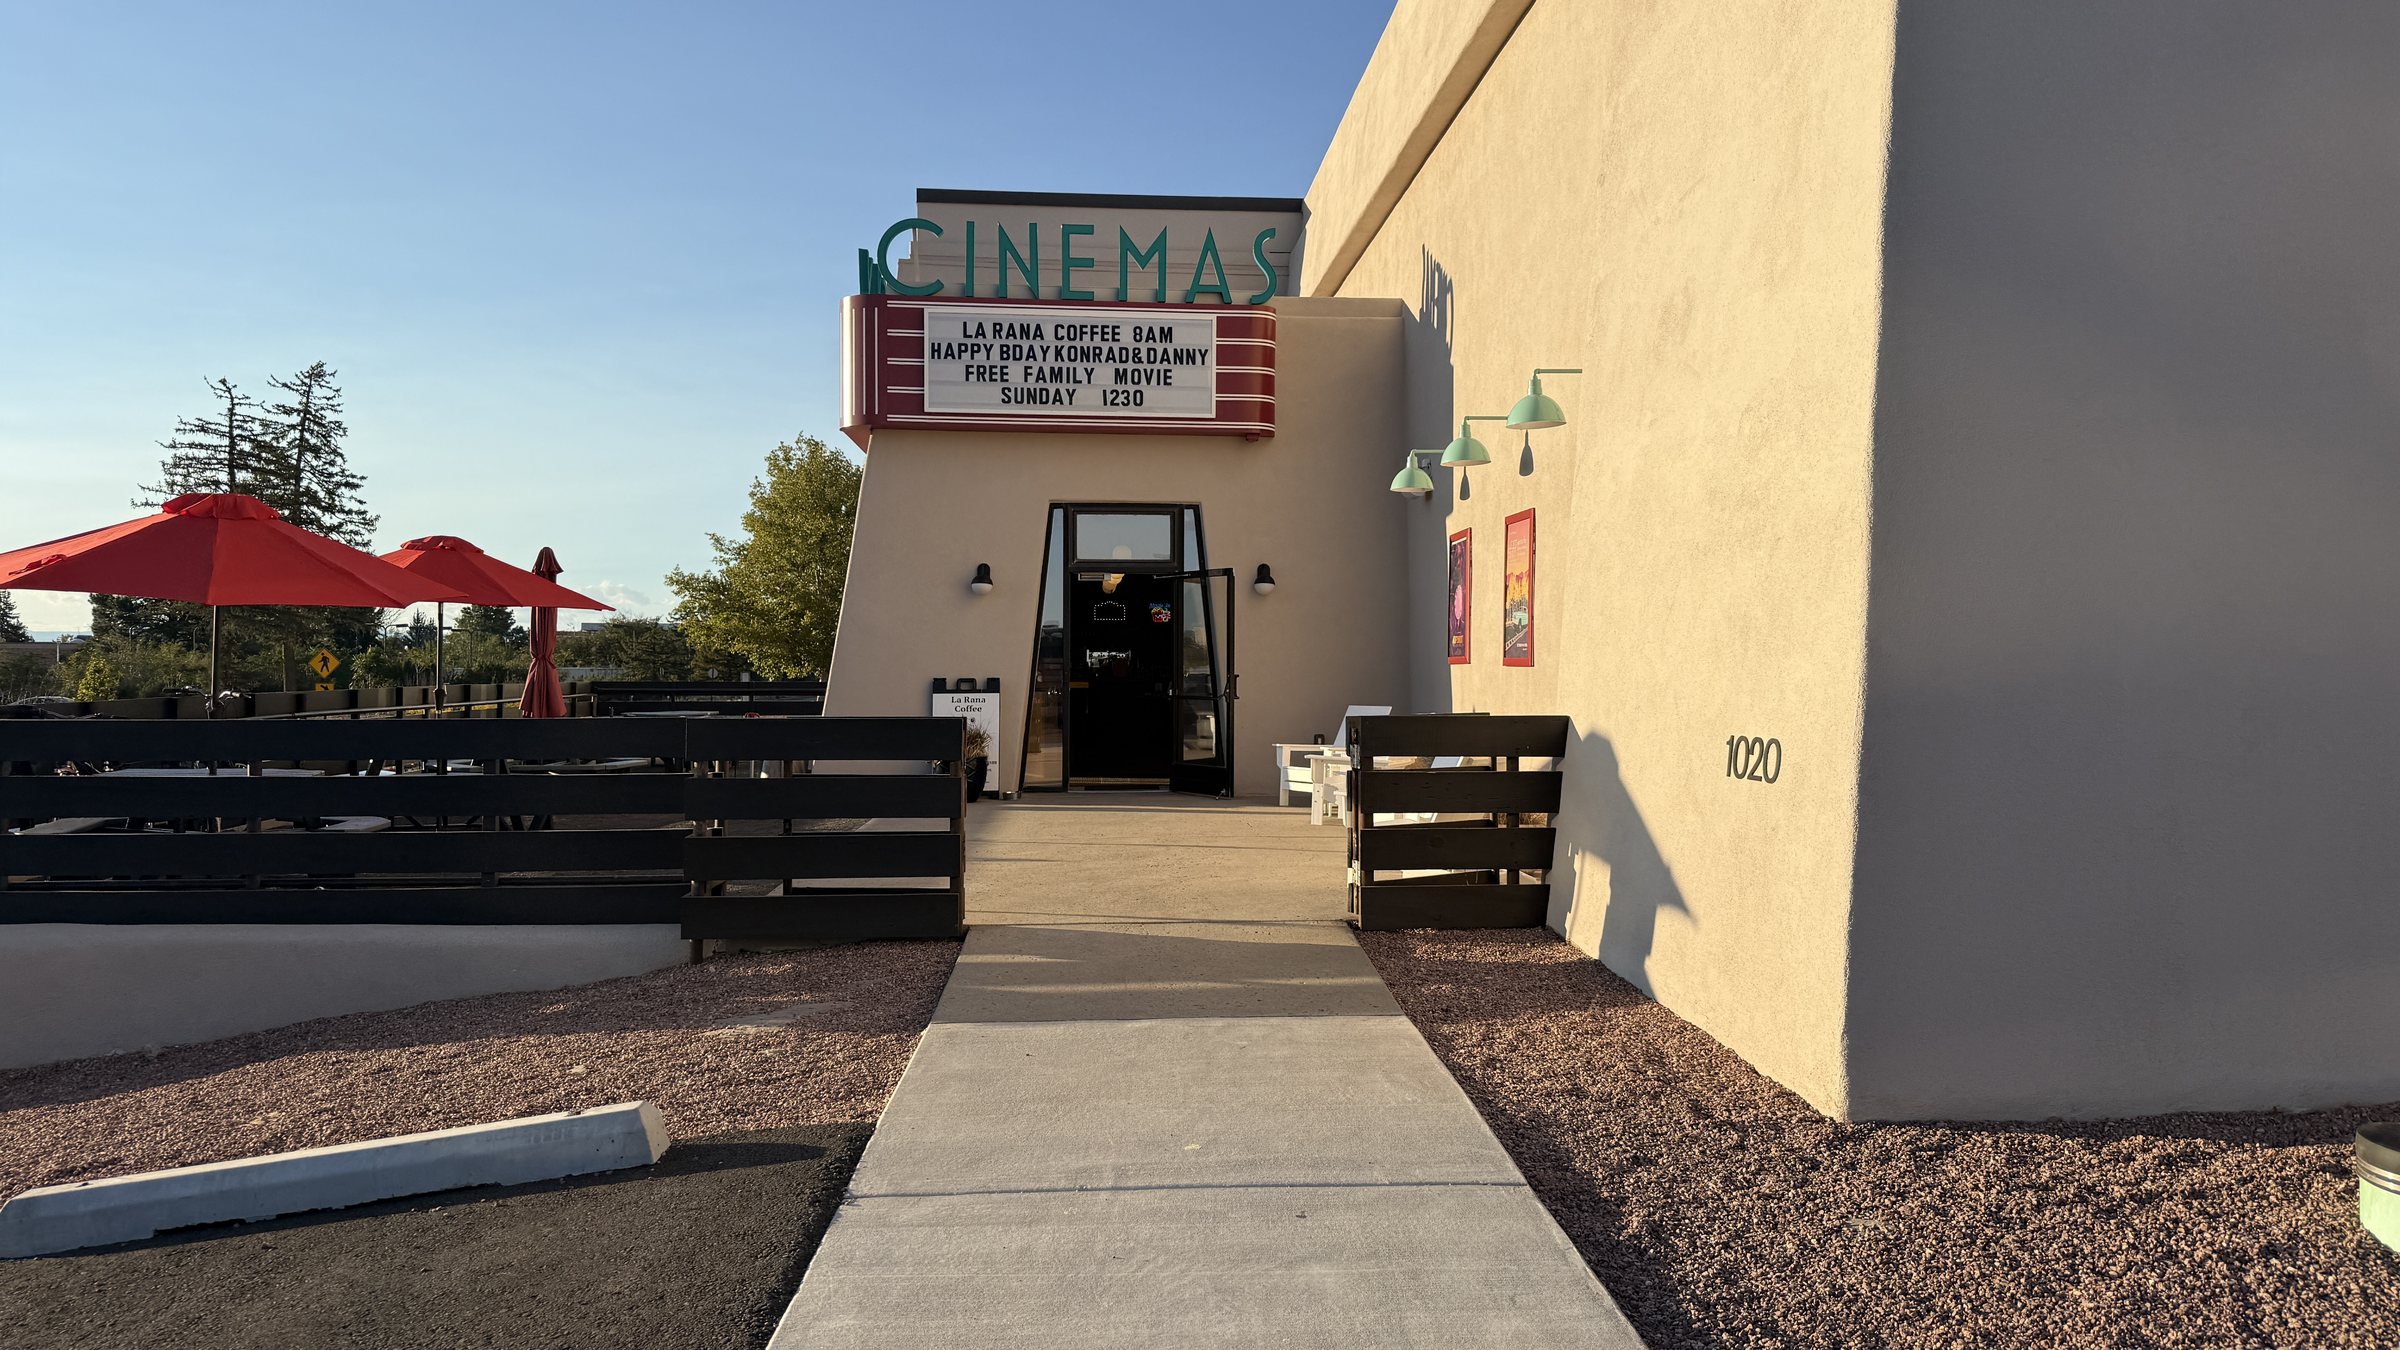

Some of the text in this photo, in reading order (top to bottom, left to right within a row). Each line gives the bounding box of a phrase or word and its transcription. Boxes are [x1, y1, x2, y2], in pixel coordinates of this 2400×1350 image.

[877, 218, 1277, 304] CINEMAS
[962, 321, 1173, 344] LA RANA COFFEE 8AM
[930, 342, 995, 360] HAPPY
[999, 344, 1051, 362] BDAY
[965, 364, 1173, 386] FREE FAMILY MOVIE
[1001, 387, 1144, 407] SUNDAY 1230
[951, 696, 986, 704] La Rana
[954, 705, 982, 713] Coffee
[1726, 735, 1782, 784] 1020
